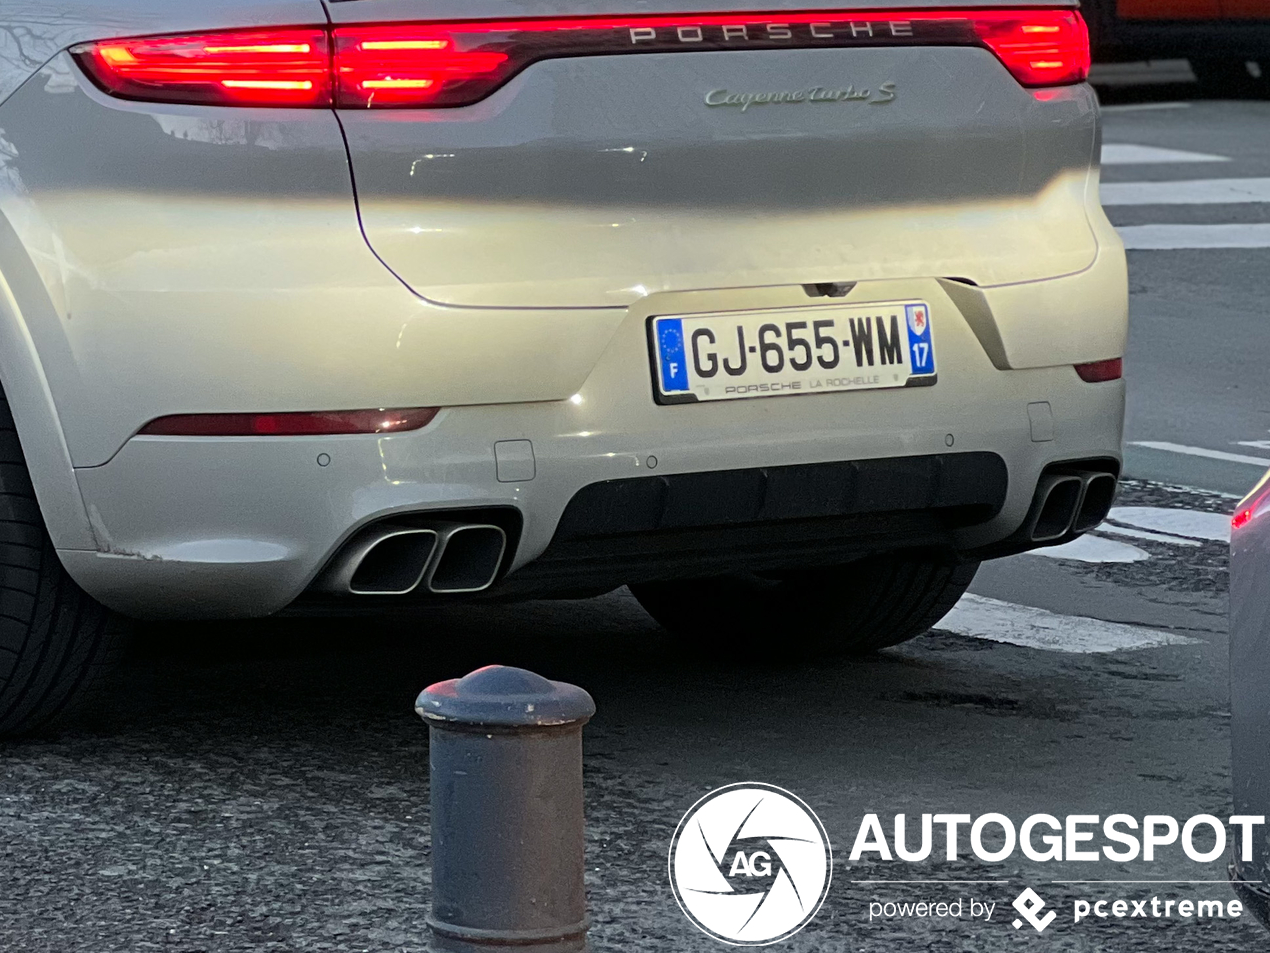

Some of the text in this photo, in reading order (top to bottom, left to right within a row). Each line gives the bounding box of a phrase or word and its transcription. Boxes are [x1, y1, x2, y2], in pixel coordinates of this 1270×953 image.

[629, 20, 914, 45] PORSCHE
[704, 80, 897, 112] Cayenne Turbo S
[669, 314, 929, 379] F GJ-655-WM 17
[725, 374, 880, 394] PORSCHE LA ROCHELLE
